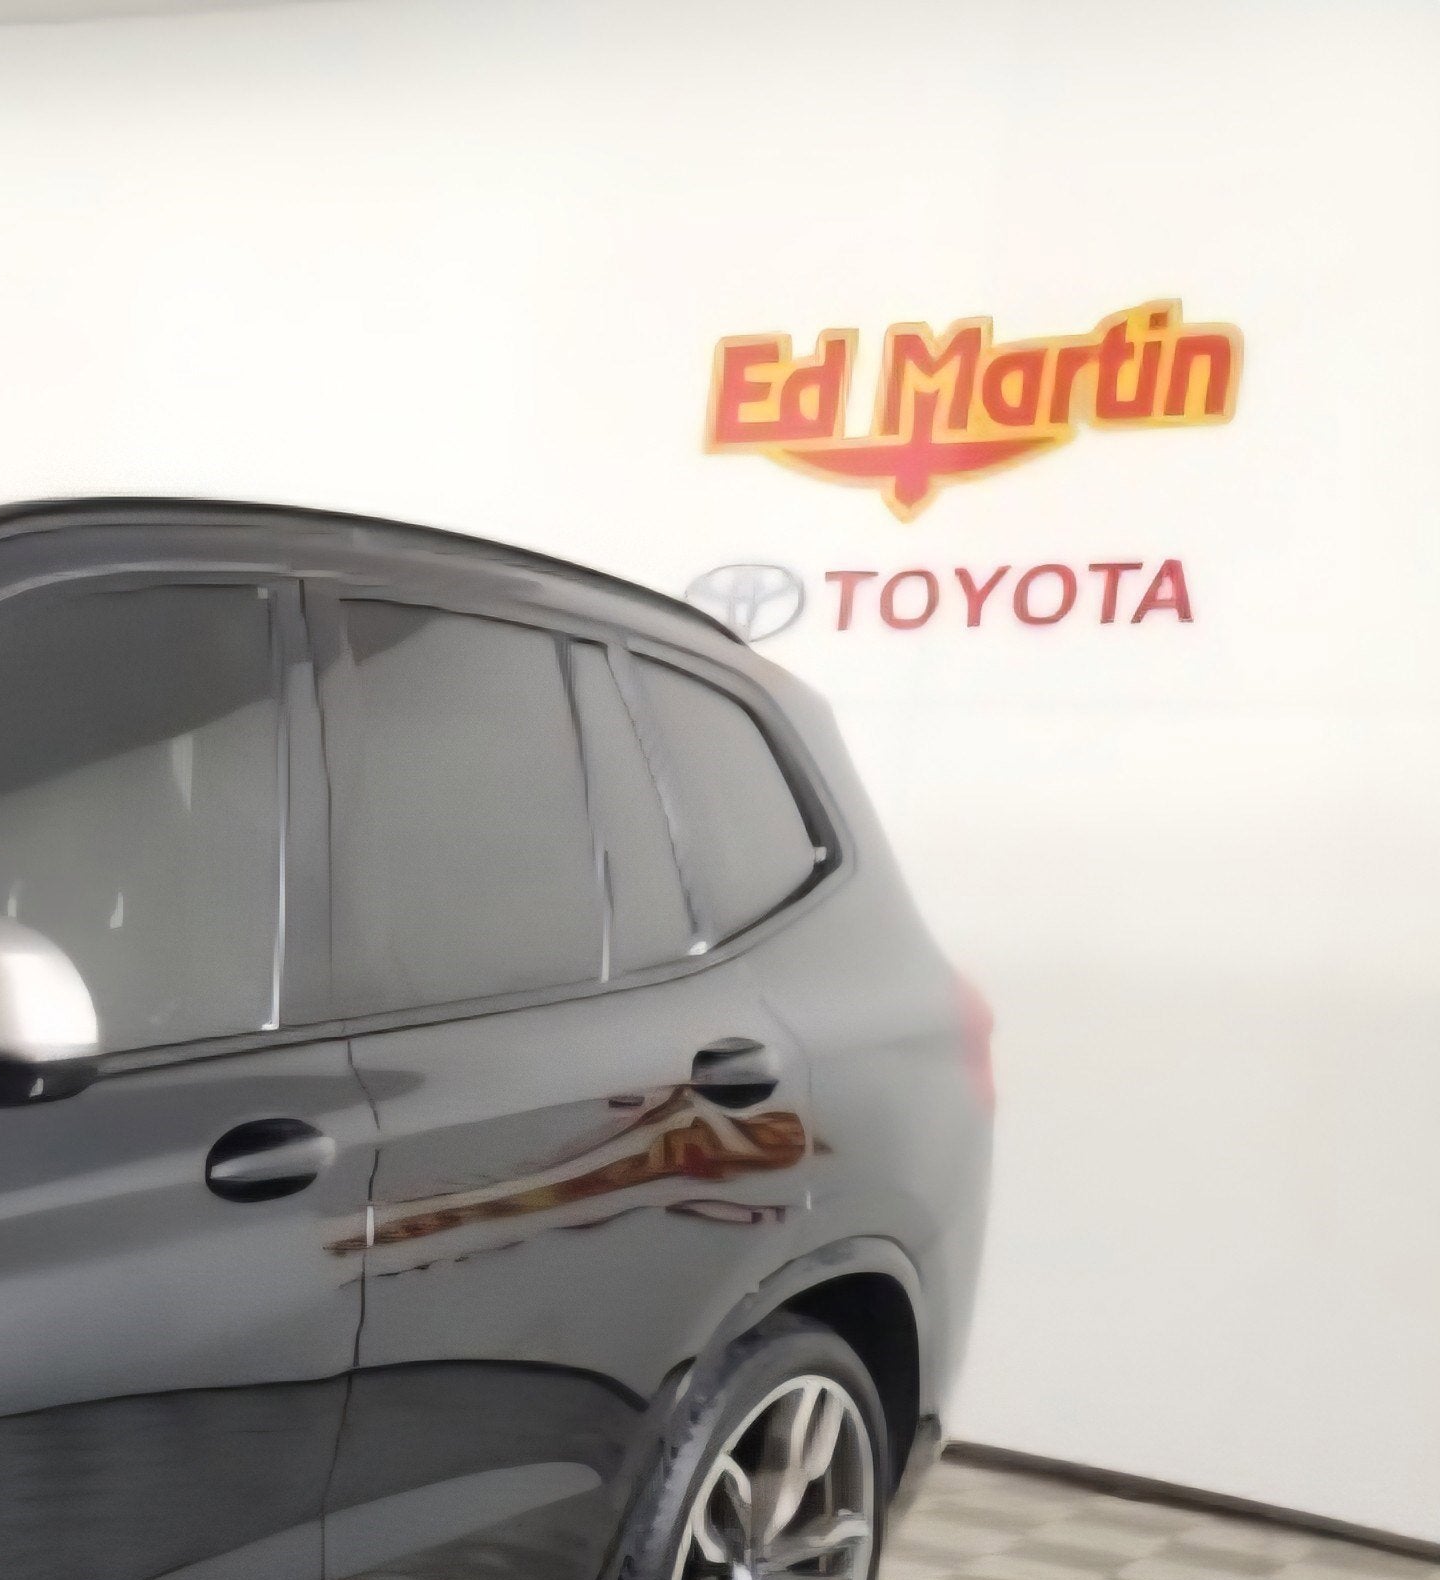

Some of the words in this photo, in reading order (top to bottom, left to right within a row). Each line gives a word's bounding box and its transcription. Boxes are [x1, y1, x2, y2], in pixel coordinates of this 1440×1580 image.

[710, 330, 852, 448] Ed
[878, 305, 1235, 438] Martin
[824, 558, 1194, 632] TOYOTA
